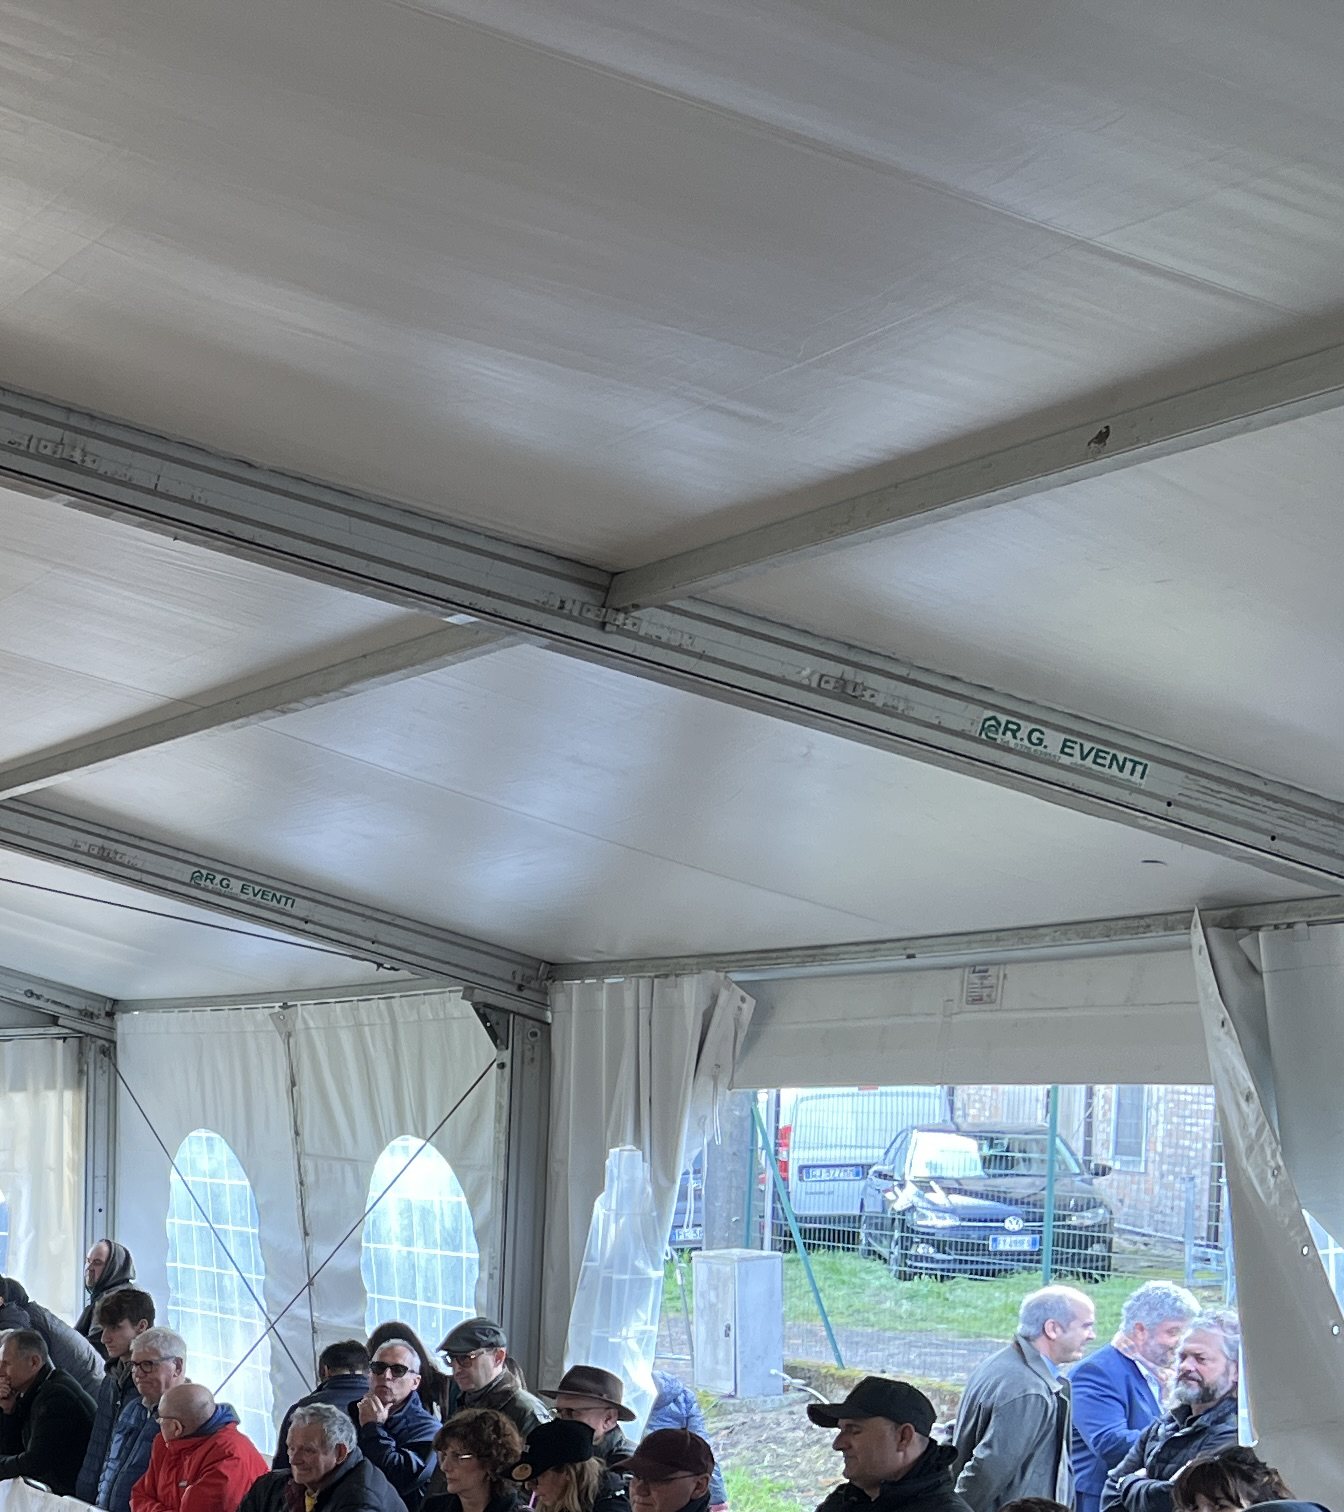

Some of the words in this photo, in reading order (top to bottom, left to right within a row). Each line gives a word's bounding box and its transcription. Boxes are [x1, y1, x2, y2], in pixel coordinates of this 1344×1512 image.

[1001, 719, 1048, 749] R.G.
[1059, 737, 1149, 780] EVENTI
[240, 883, 296, 908] EVENTI
